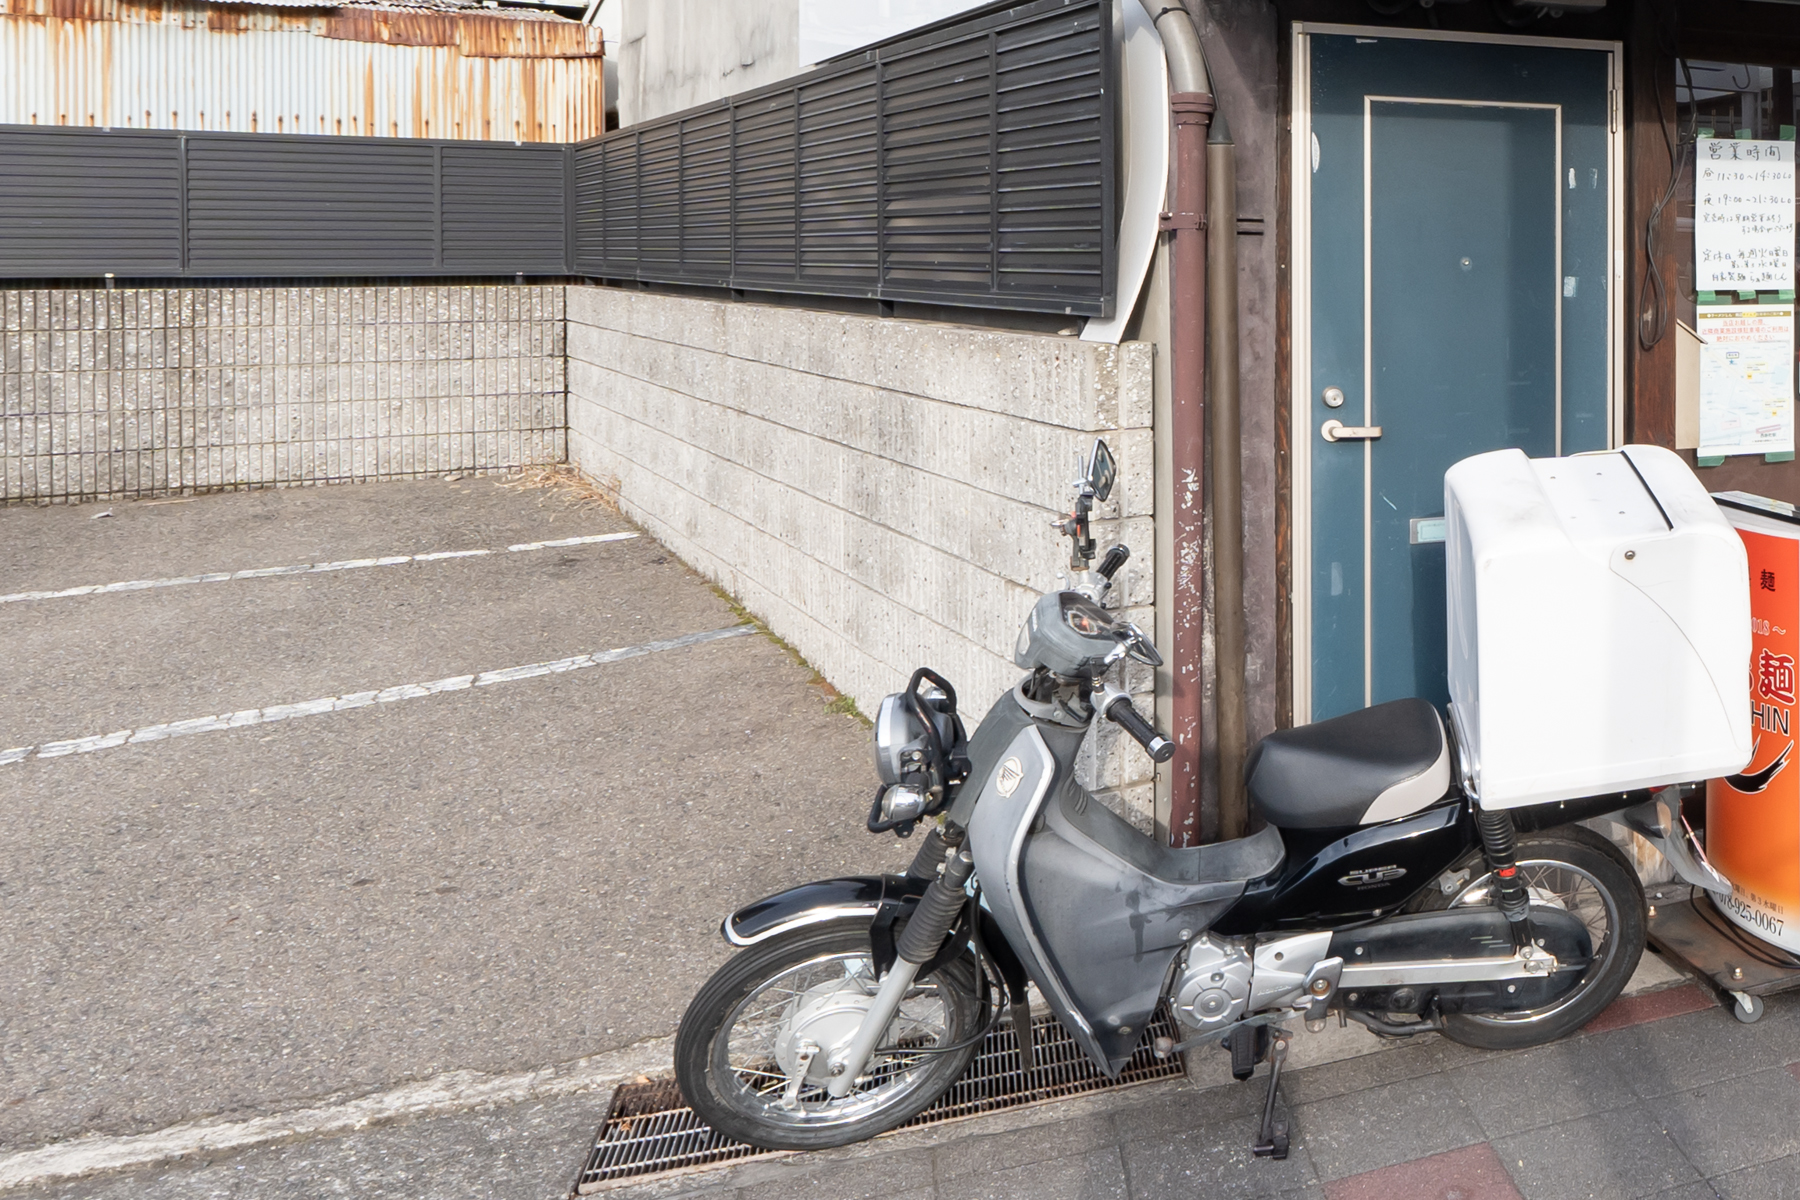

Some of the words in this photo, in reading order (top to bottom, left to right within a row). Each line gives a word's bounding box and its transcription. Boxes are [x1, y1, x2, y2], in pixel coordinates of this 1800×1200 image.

[1709, 142, 1781, 161] 営業時間
[1750, 648, 1797, 706] 麺
[1750, 698, 1790, 737] HIN
[1337, 867, 1407, 886] CUB
[1349, 863, 1397, 875] SUPER
[1357, 881, 1391, 891] HONDA
